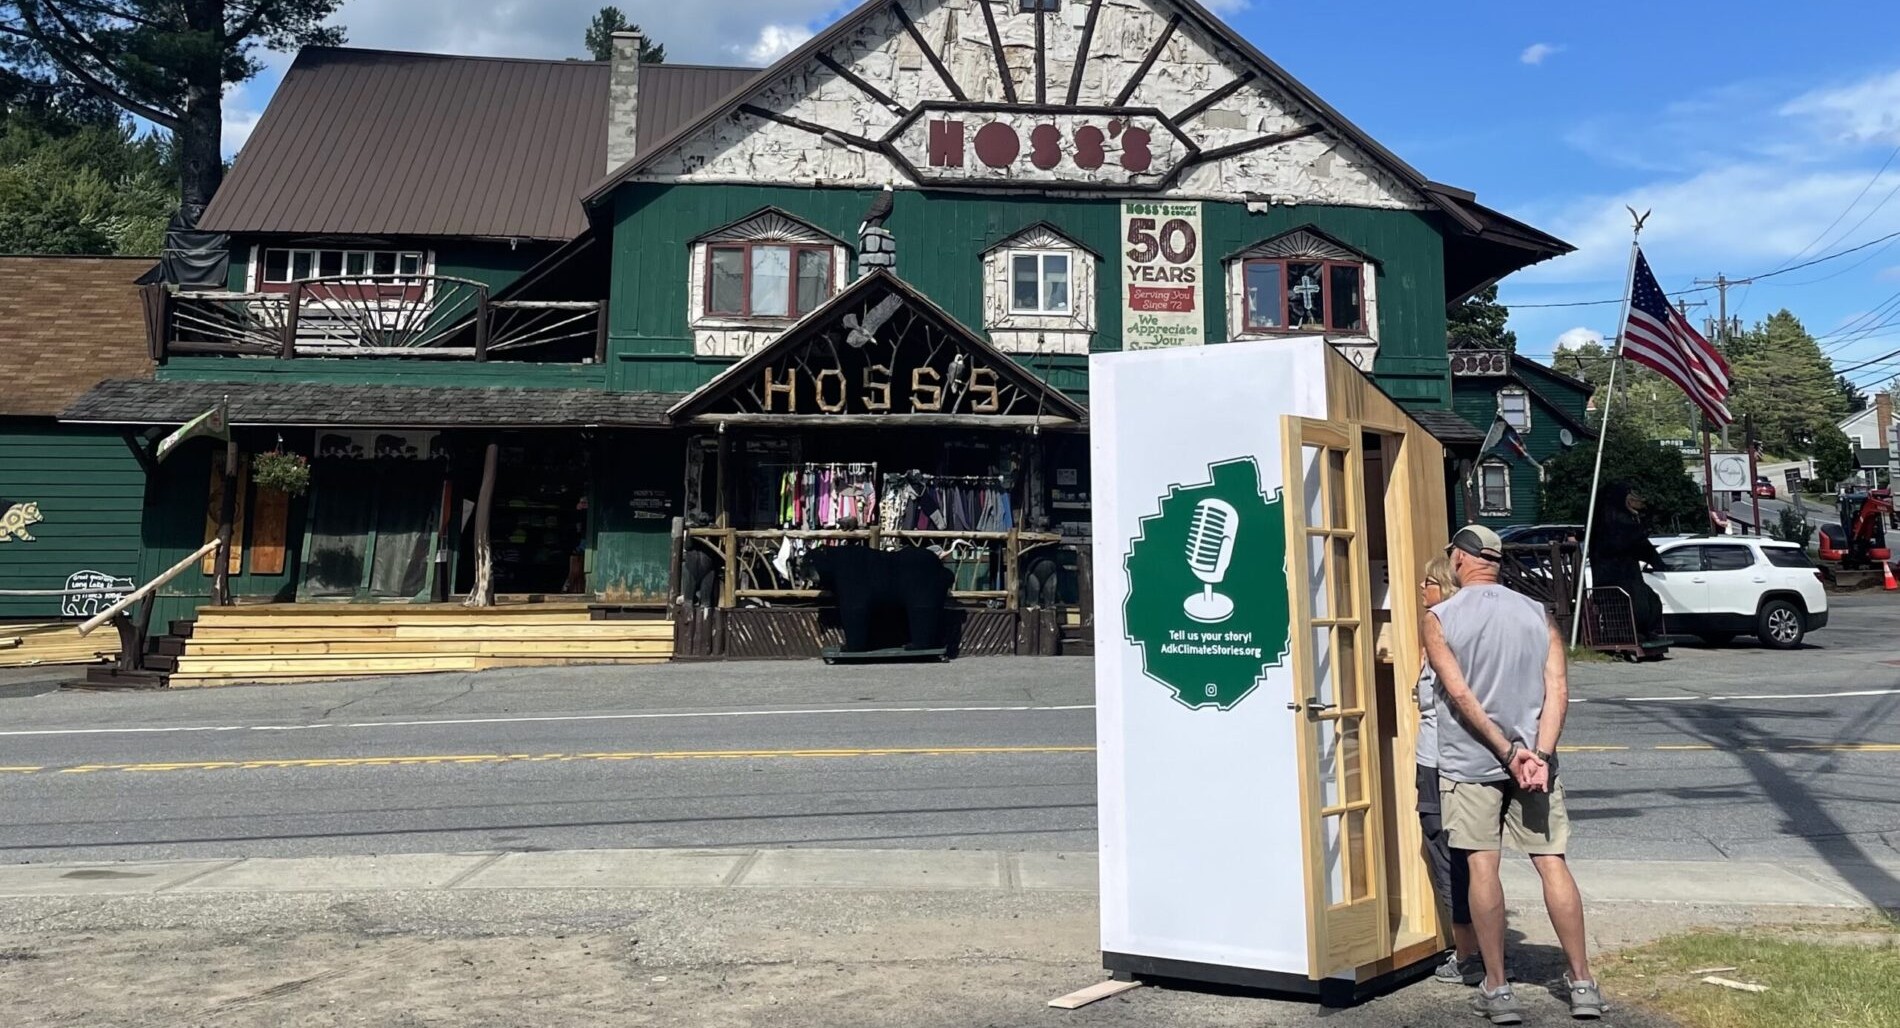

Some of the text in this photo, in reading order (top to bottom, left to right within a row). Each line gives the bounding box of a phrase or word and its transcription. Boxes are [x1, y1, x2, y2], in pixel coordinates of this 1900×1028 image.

[929, 120, 1151, 172] HOSS'S
[1126, 203, 1169, 216] HOSS'S
[1126, 218, 1197, 264] 50
[1127, 265, 1196, 283] YEARS
[1134, 289, 1190, 302] Serving You
[1142, 300, 1168, 310] Since
[1138, 314, 1159, 325] We
[1127, 322, 1198, 336] Appreciate
[1143, 334, 1185, 346] Your
[1169, 630, 1252, 644] Tell us your story!
[1161, 643, 1262, 659] AdkClimateStories.org
